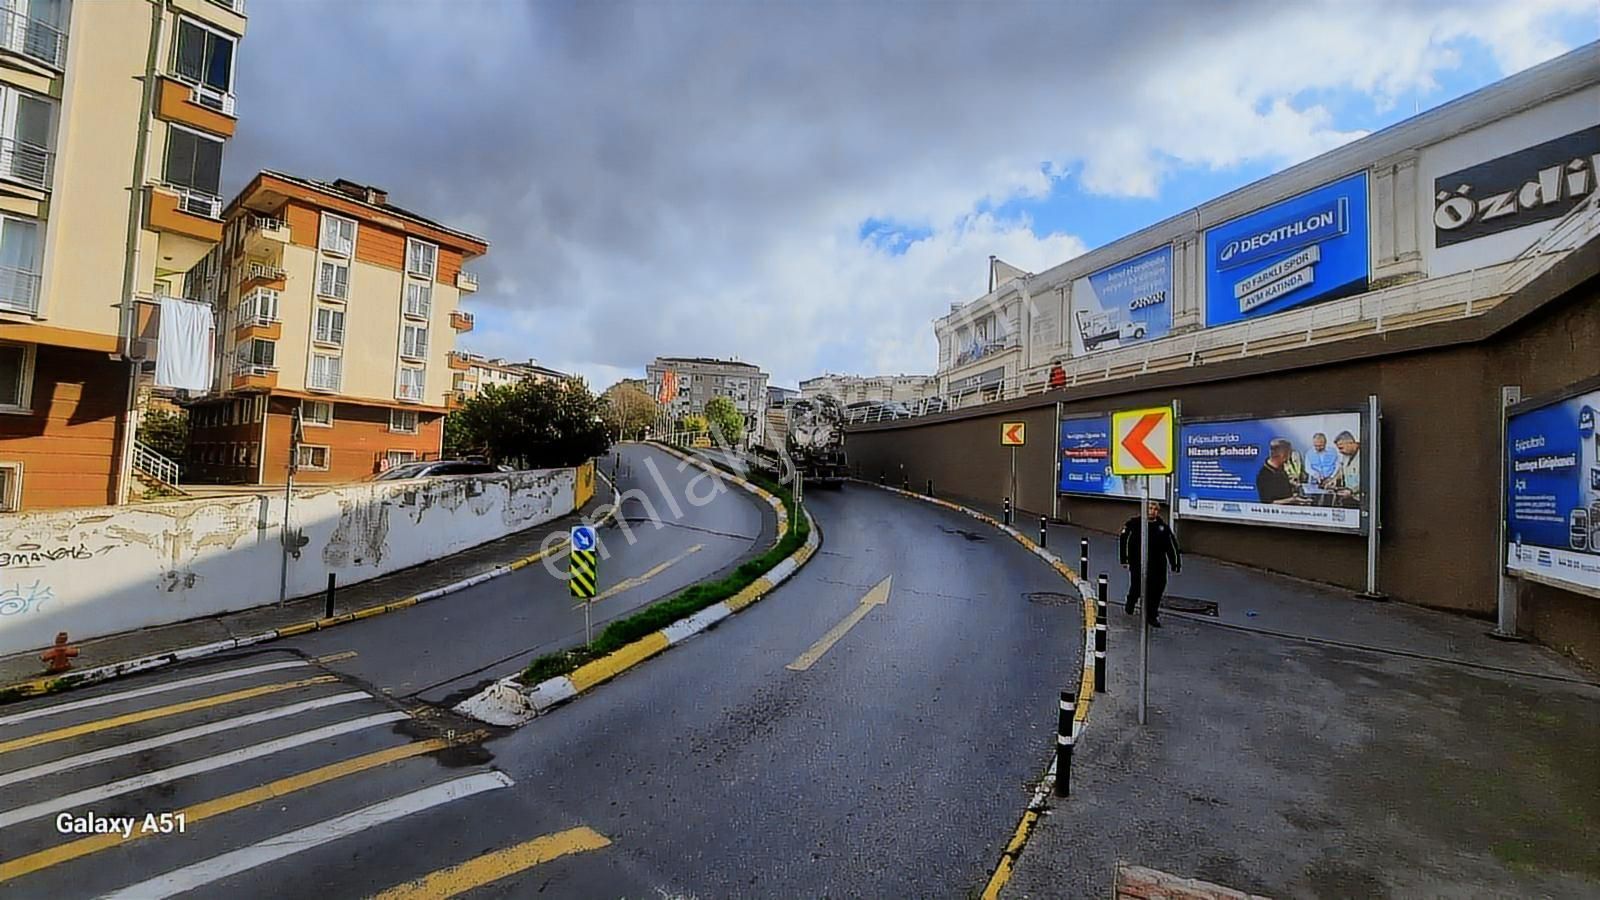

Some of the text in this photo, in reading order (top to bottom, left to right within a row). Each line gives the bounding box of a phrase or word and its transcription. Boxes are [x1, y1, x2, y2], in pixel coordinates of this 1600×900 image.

[1241, 211, 1333, 253] DECATHLON
[1252, 264, 1284, 288] FARKLI
[1284, 251, 1310, 271] SPOR
[1246, 273, 1304, 307] AVM KATINDA
[1188, 445, 1259, 457] Hizmet Sahada
